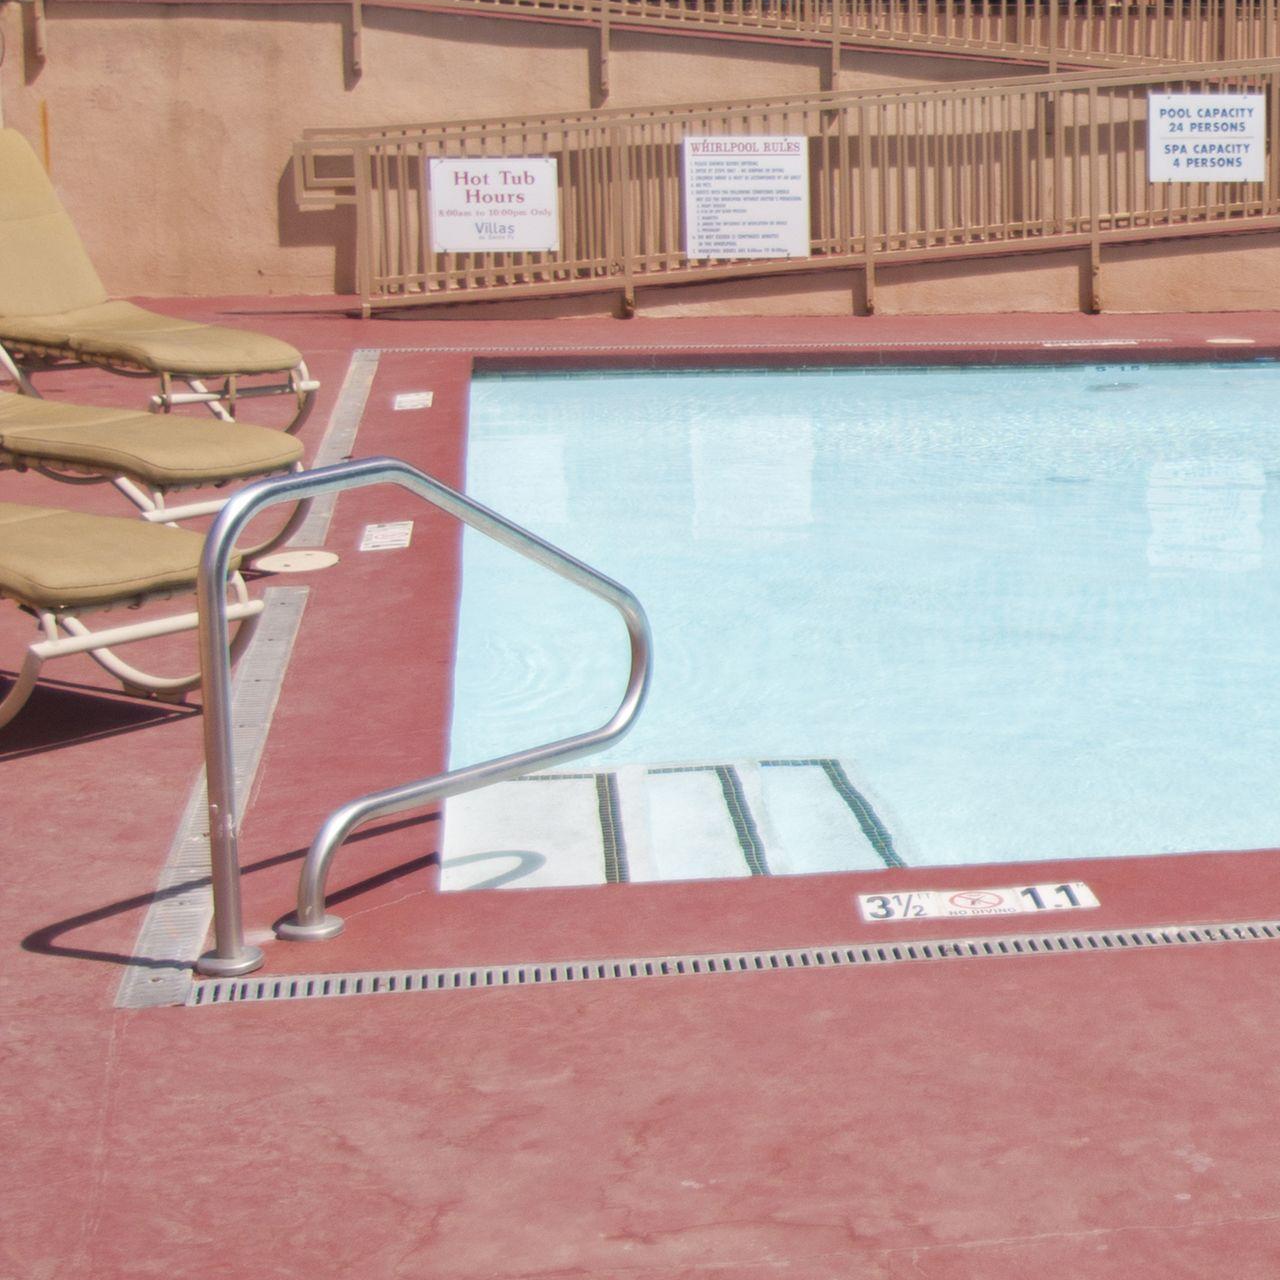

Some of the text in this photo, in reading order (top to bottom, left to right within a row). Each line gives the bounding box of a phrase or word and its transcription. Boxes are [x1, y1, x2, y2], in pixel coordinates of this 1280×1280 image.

[1160, 108, 1254, 118] POOL CAPACITY
[1169, 122, 1246, 132] 24 PERSONS
[690, 142, 801, 153] WHIRLPOOL RULES
[1164, 144, 1250, 154] SPA CAPACITY
[1173, 157, 1242, 168] 4 PERSONS
[454, 170, 536, 186] Hot Tub
[466, 189, 525, 204] Hours
[475, 222, 516, 234] Villas
[1020, 884, 1082, 909] 1.1
[971, 907, 1017, 915] DIVING
